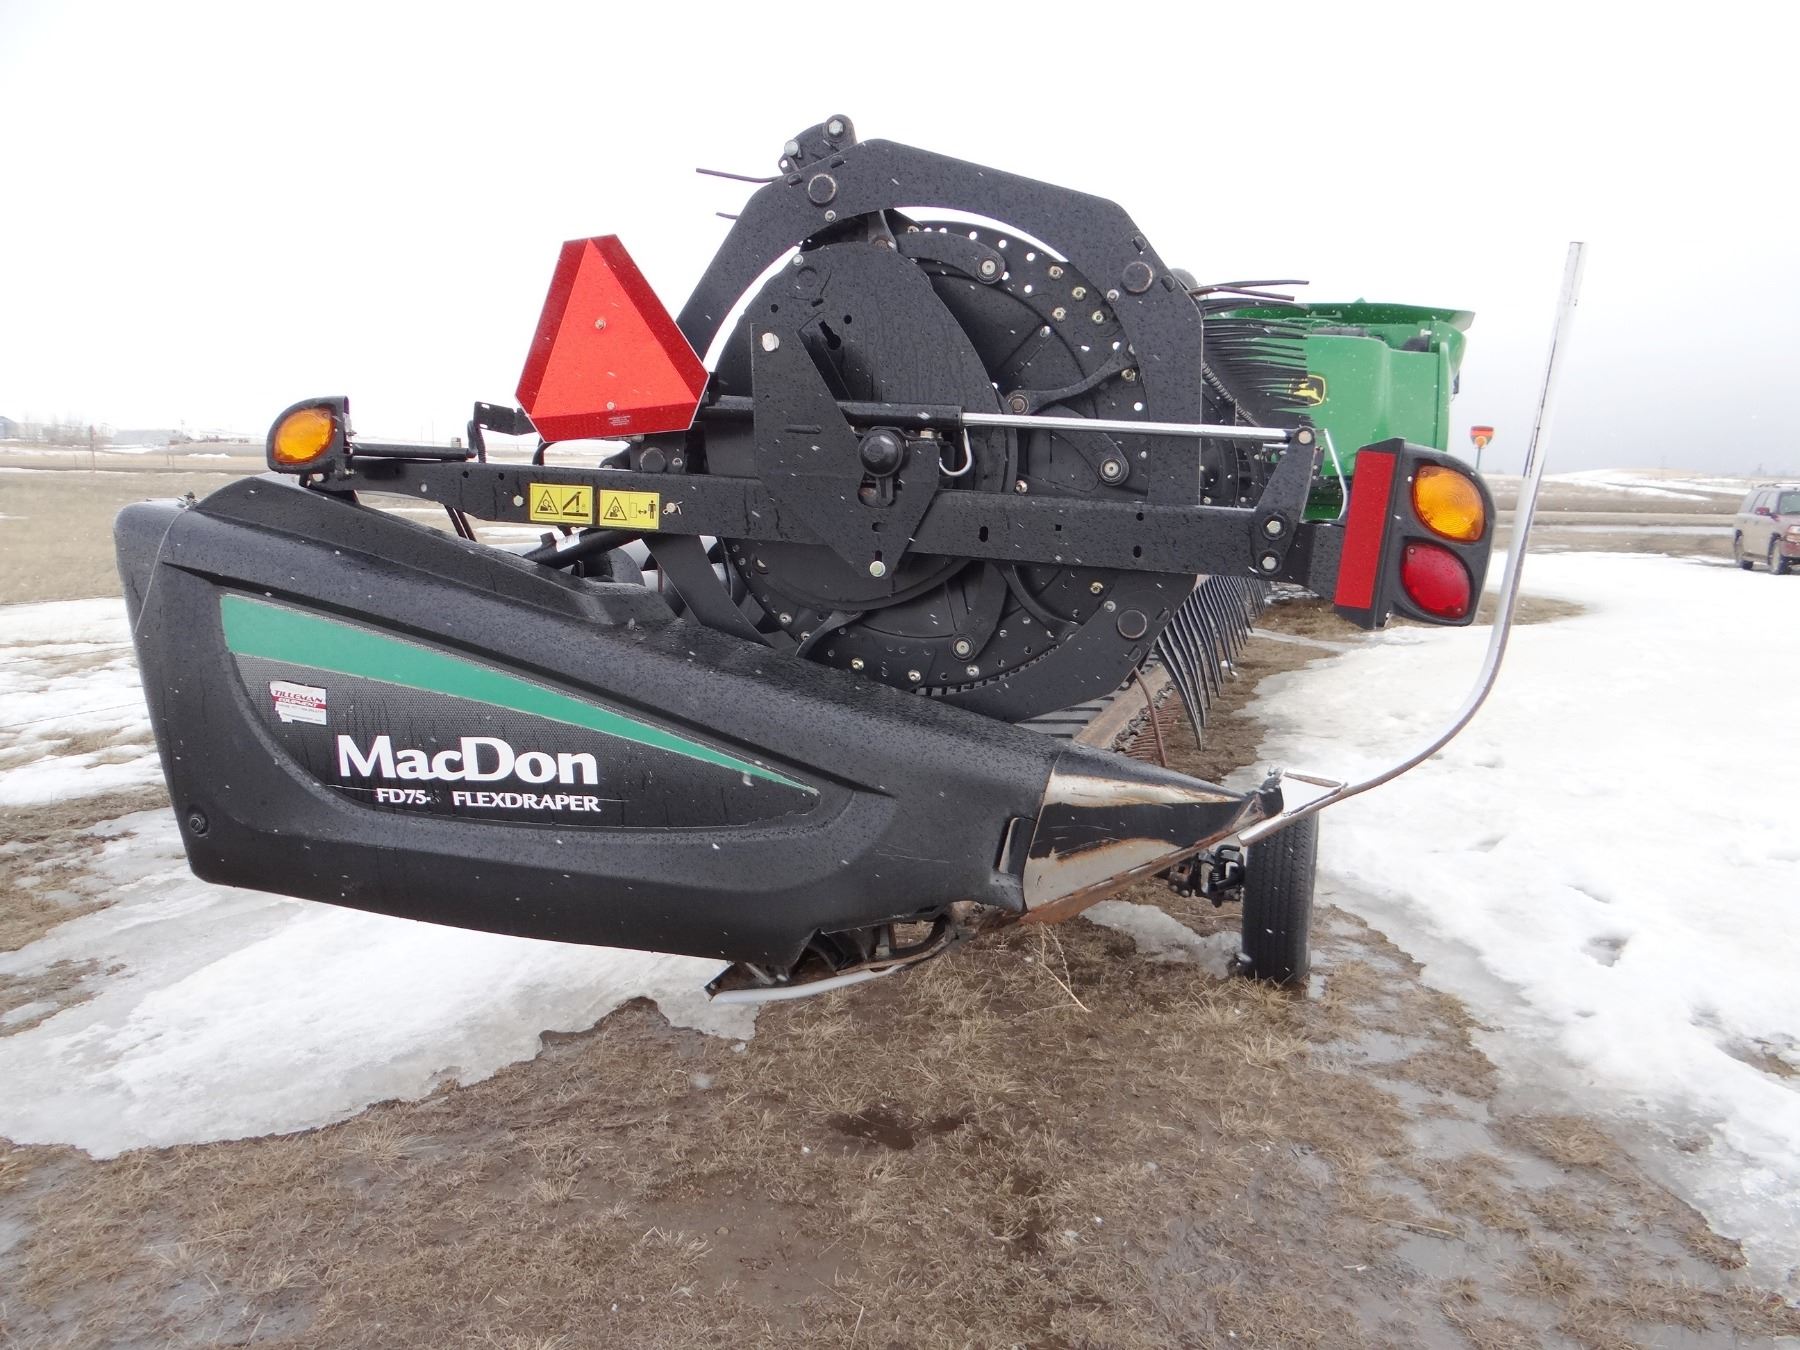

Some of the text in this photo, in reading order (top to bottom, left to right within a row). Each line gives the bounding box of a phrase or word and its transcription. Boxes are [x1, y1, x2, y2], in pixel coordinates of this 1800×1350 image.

[274, 690, 323, 703] TILLEMAN
[337, 734, 599, 785] MacDon
[452, 790, 602, 812] FLEXDRAPER
